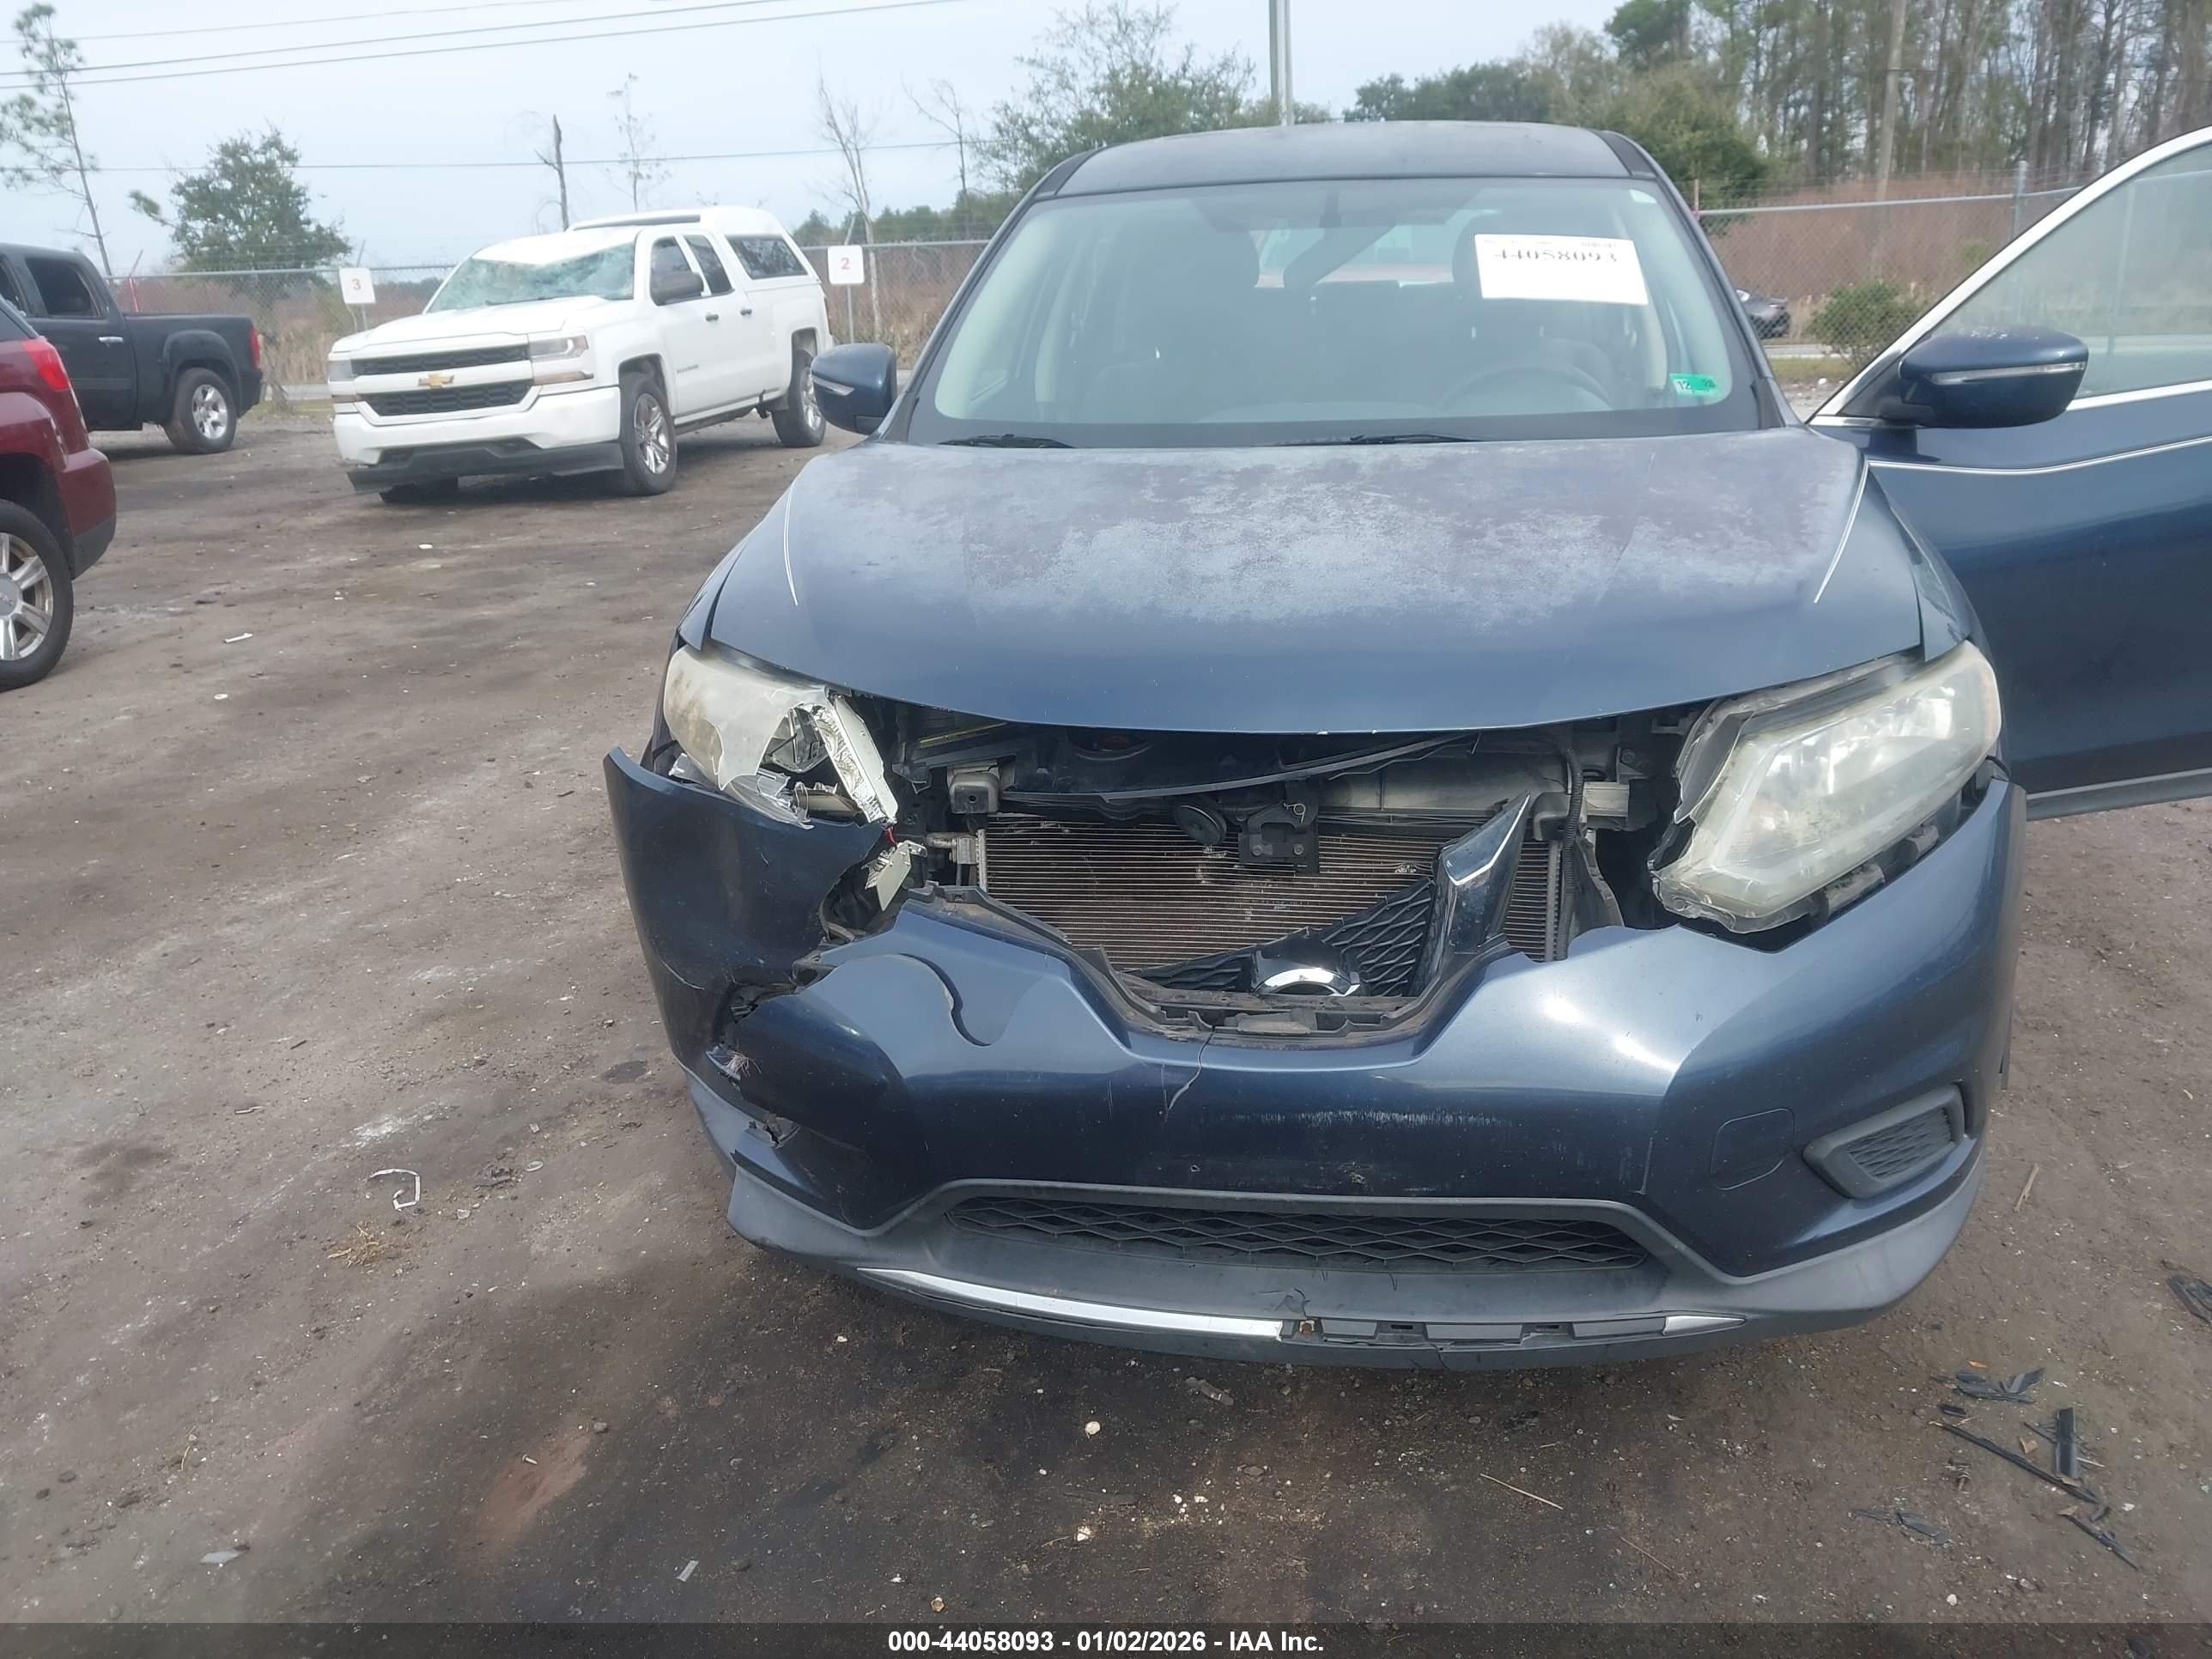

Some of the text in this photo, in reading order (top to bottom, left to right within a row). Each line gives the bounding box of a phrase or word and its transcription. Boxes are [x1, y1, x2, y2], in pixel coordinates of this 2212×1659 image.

[1494, 249, 1618, 263] 44058093
[841, 257, 851, 270] 2
[352, 278, 362, 290] 3
